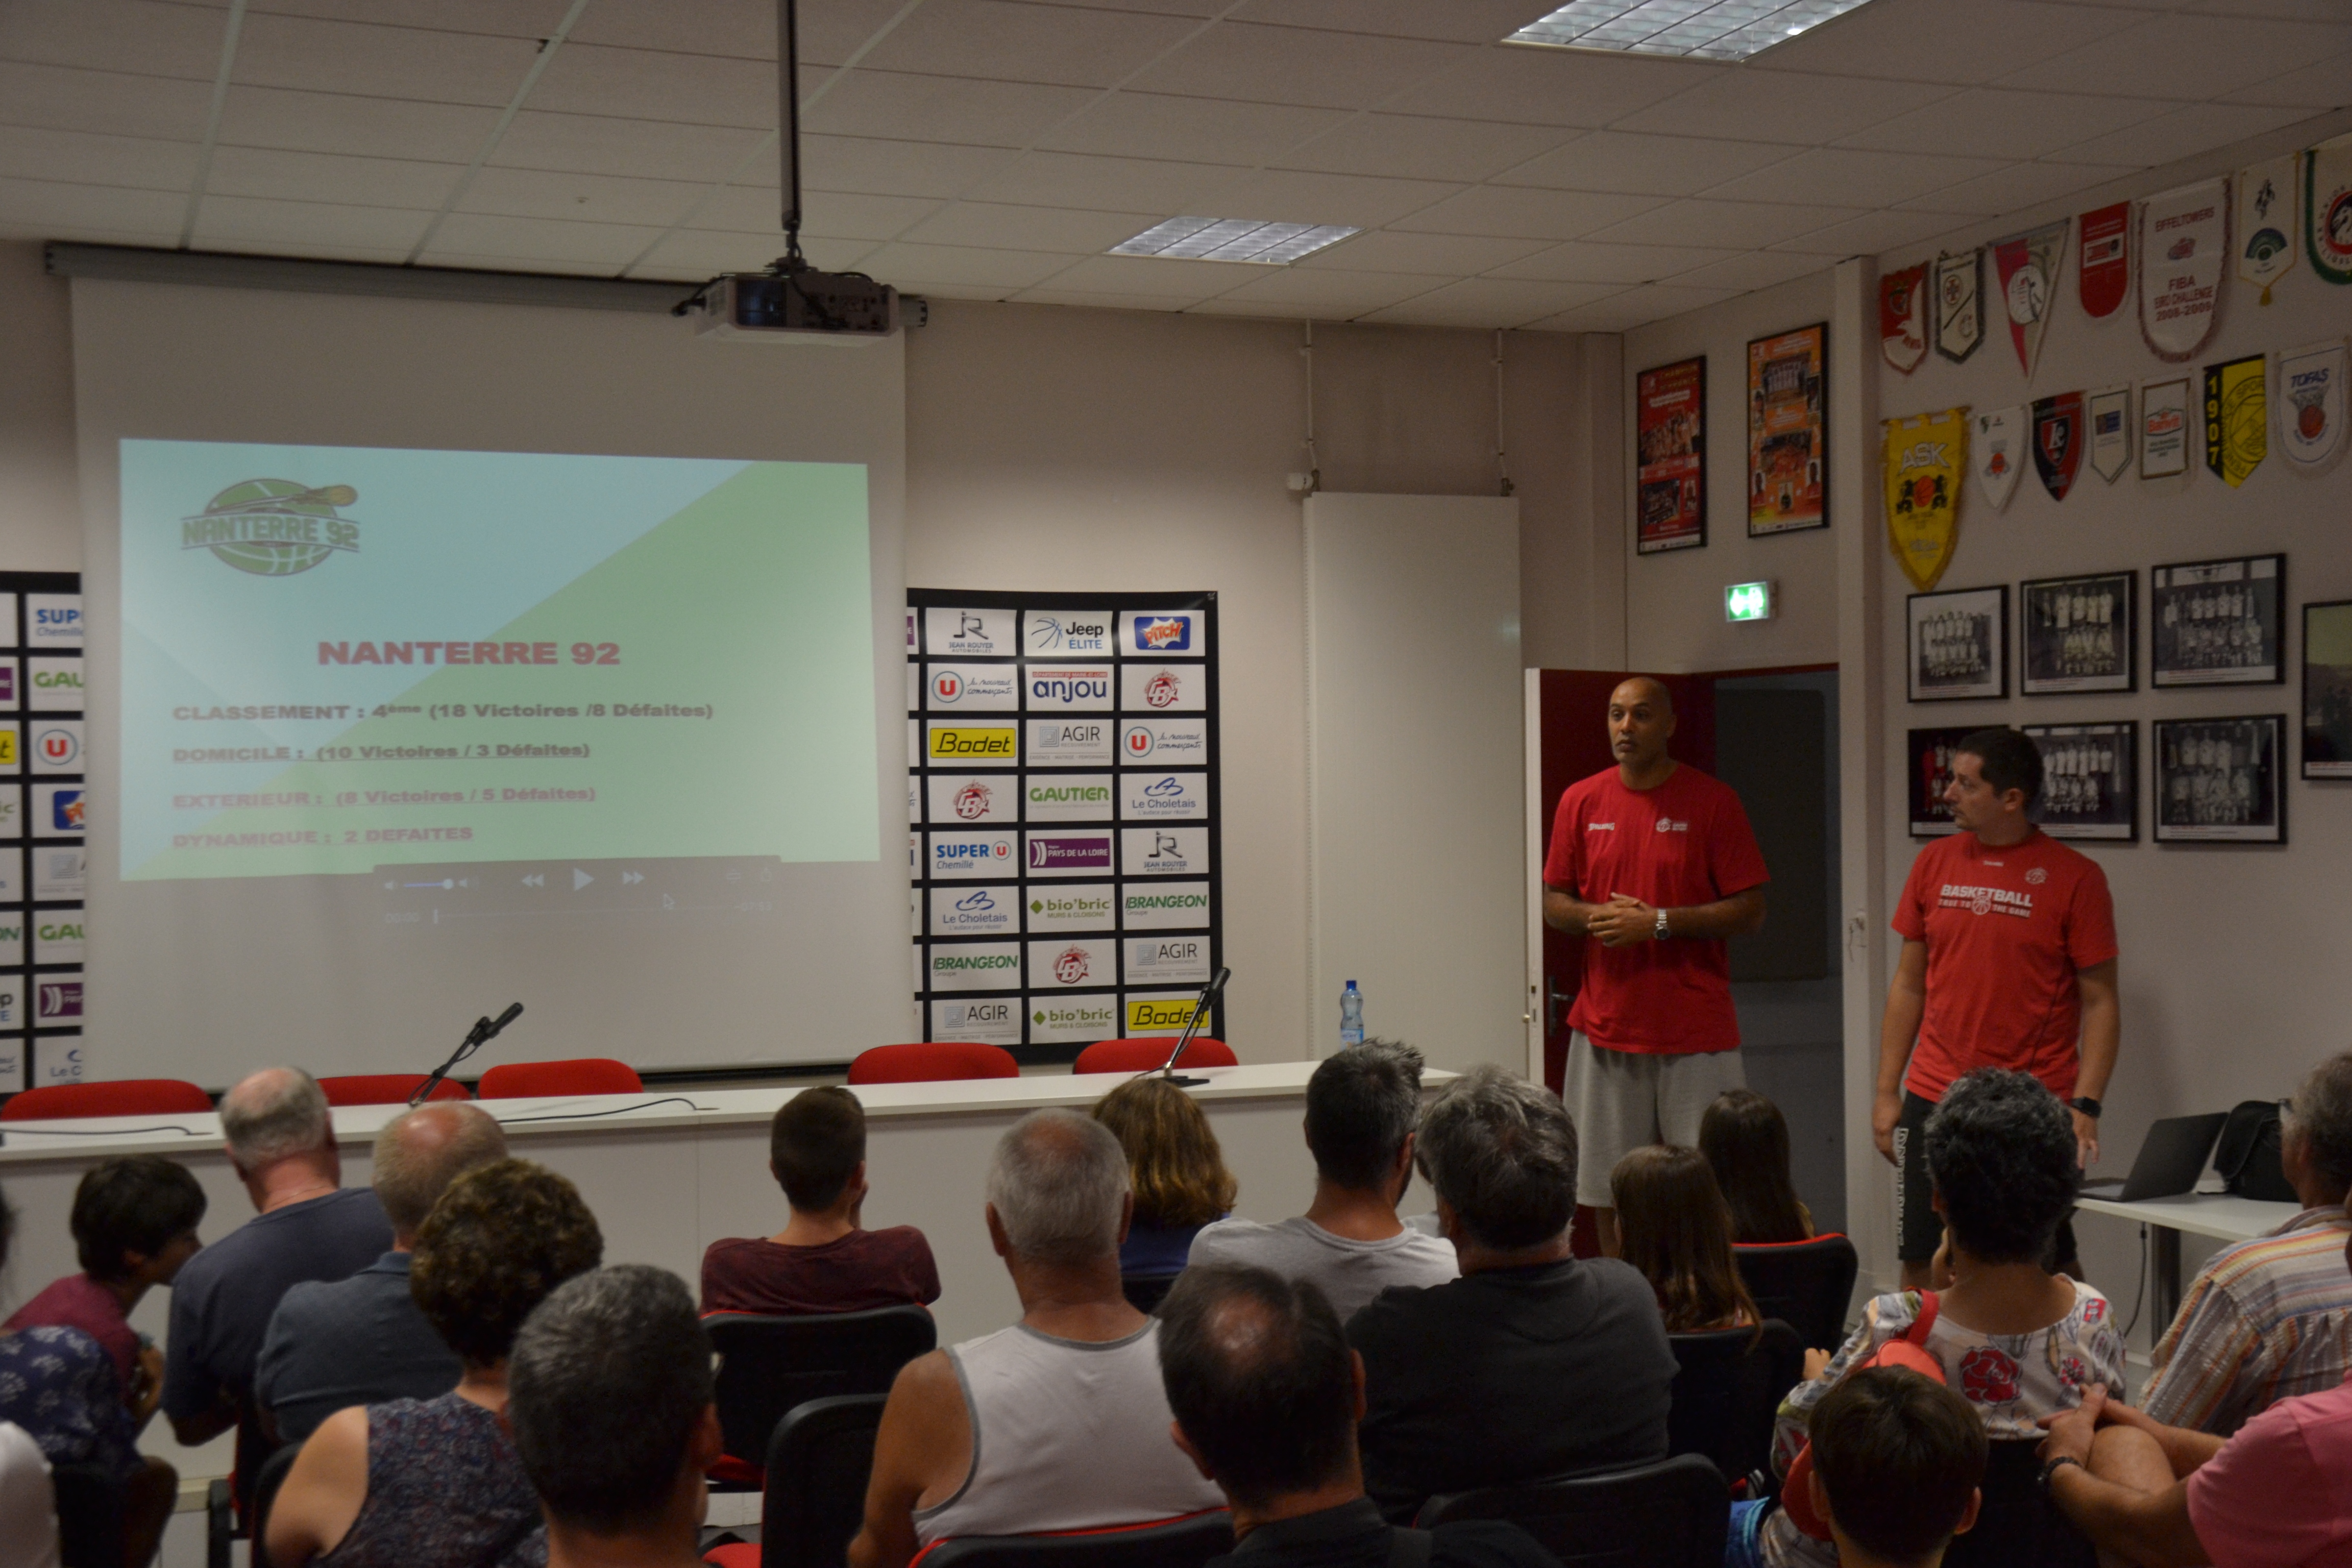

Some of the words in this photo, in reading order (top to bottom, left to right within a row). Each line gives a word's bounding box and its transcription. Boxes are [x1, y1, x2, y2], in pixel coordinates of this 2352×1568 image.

[2168, 275, 2196, 290] FIBA
[1897, 442, 1951, 476] ASK
[182, 516, 319, 545] NANTERRE
[326, 521, 359, 549] 92
[37, 609, 83, 624] SUP
[1066, 622, 1104, 638] Jeep
[1069, 638, 1103, 649] ÉLITE
[317, 641, 558, 665] NANTERRE
[570, 642, 621, 665] 92
[940, 680, 956, 696] U
[1033, 680, 1107, 703] anjou
[173, 705, 351, 721] CLASSEMENT
[372, 704, 422, 718] 4ème
[430, 704, 467, 721] (18
[473, 704, 579, 718] Victoires
[612, 703, 713, 720] Défaites)
[1061, 726, 1100, 742] AGIR
[46, 739, 66, 757] U
[936, 732, 1011, 753] Bodet
[1131, 735, 1147, 750] U
[173, 747, 290, 763] DOMICILE
[359, 745, 458, 759] Victoires
[476, 744, 489, 757] 3
[496, 744, 591, 758] Défaites)
[173, 792, 310, 807] EXTERIEUR
[364, 790, 464, 803] Victoires
[482, 788, 495, 801] 5
[502, 788, 596, 802] Défaites)
[1029, 787, 1110, 802] GAUTIER
[1132, 800, 1146, 808] Le
[1147, 798, 1196, 808] Choletais
[173, 830, 318, 848] DYNAMIQUE
[344, 830, 358, 843] 2
[365, 827, 473, 843] DEFAITES
[937, 844, 990, 858] SUPER
[996, 846, 1007, 856] U
[937, 860, 974, 869] Chemillé
[1126, 895, 1207, 909] BRANGEON
[1940, 884, 2033, 908] BASKETBALL
[1047, 899, 1111, 911] bio'bric
[1992, 904, 2007, 913] THE
[2008, 907, 2031, 918] GAME
[943, 914, 956, 923] Le
[958, 913, 1008, 923] Choletais
[1158, 943, 1197, 959] AGIR
[934, 955, 1018, 970] BRANGEON
[967, 1005, 1009, 1021] AGIR
[1049, 1009, 1113, 1021] bio'bric
